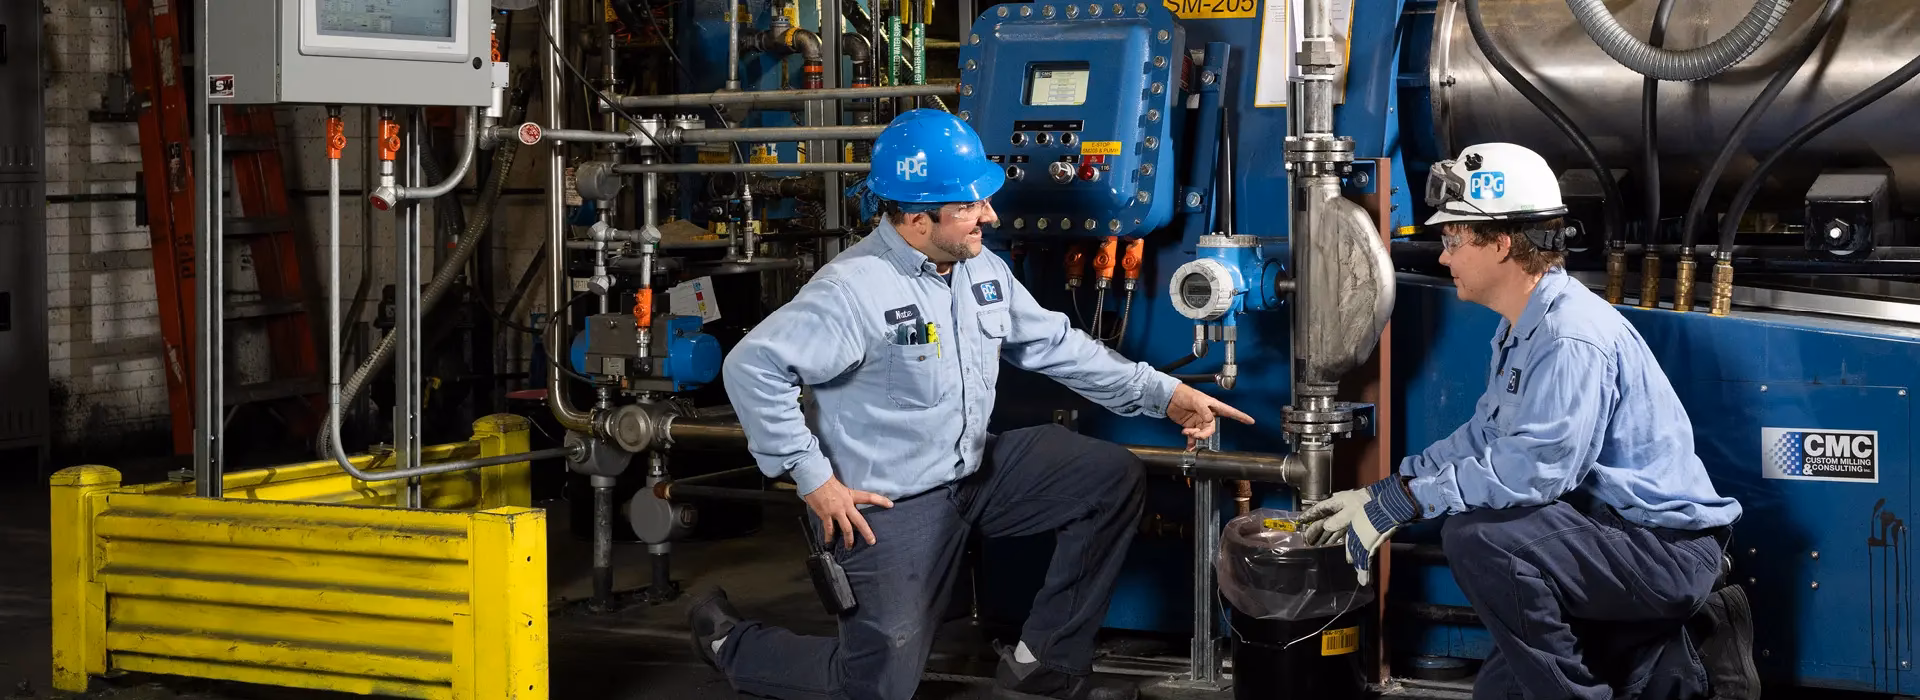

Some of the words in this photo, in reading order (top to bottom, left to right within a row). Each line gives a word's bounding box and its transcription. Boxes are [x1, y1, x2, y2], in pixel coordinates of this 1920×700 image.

[1166, 0, 1255, 13] SM-205
[893, 17, 901, 36] SUPPLY
[893, 37, 901, 56] WATER
[913, 37, 922, 56] RETURN
[913, 56, 922, 74] WATER
[896, 157, 928, 181] PPG
[1471, 173, 1504, 199] PPG
[981, 283, 998, 300] PPG
[1804, 434, 1872, 458] CMC
[1839, 458, 1871, 466] MILLING
